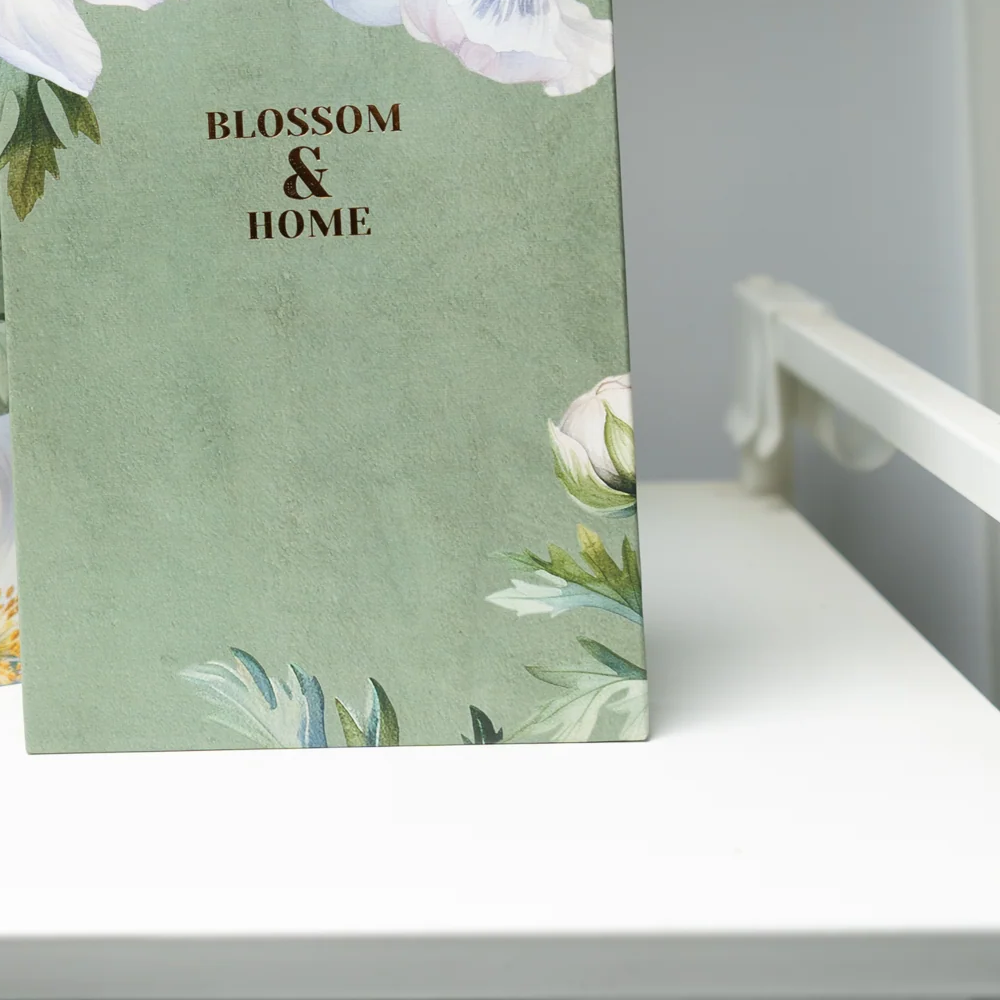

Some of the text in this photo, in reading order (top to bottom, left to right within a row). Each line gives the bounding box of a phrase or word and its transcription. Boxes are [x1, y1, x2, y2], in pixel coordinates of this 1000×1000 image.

[205, 102, 403, 140] BLOSSOM
[283, 145, 333, 200] &
[247, 206, 372, 240] HOME
